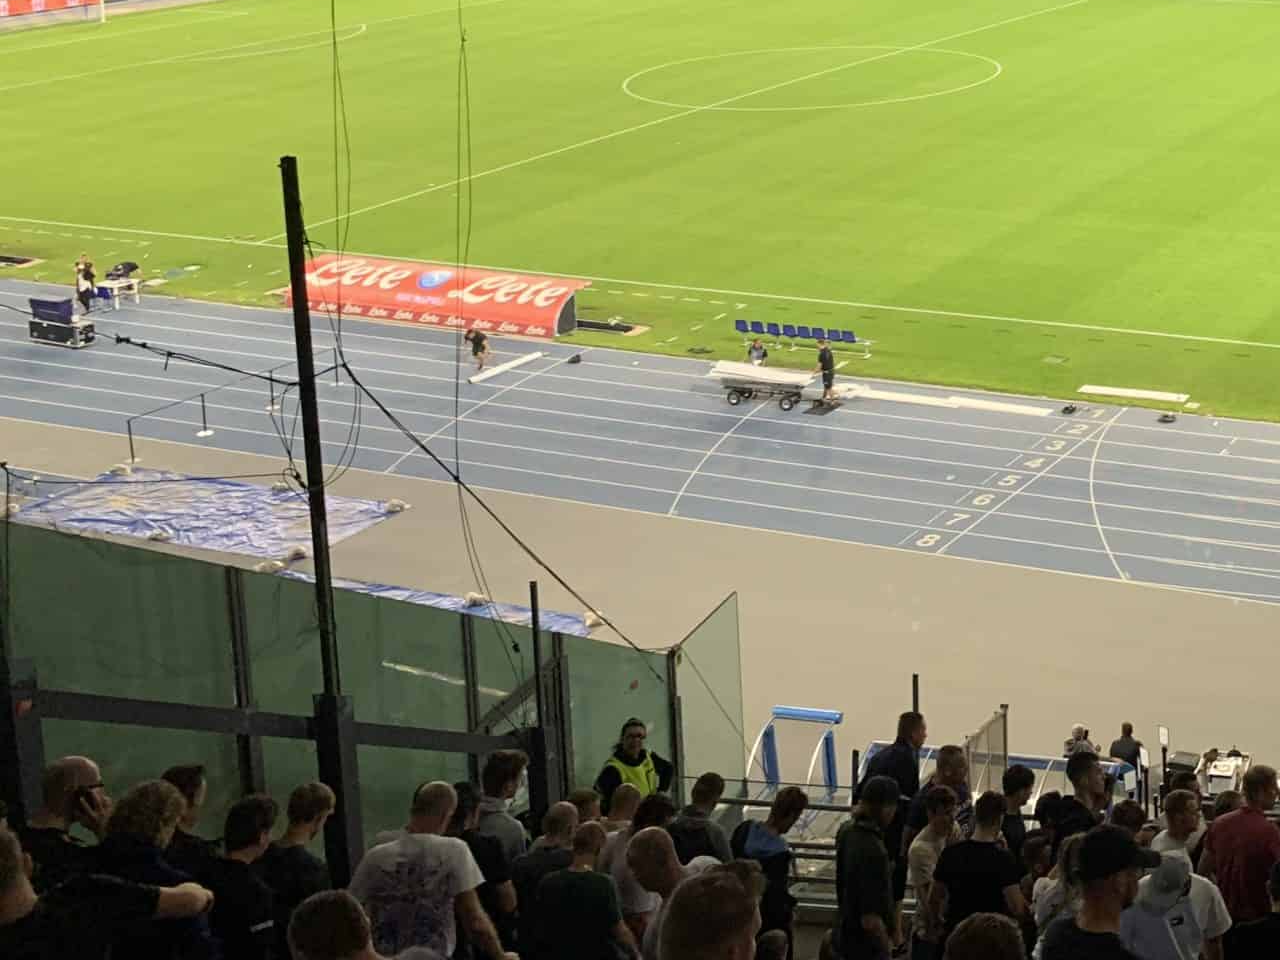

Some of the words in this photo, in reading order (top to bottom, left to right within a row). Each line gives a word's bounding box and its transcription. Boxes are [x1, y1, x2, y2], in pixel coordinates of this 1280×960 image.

[305, 258, 412, 289] Lete
[448, 275, 569, 308] Lete
[1066, 424, 1089, 434] 2
[1045, 440, 1067, 451] 3
[1023, 457, 1047, 468] 4
[997, 475, 1023, 486] 5
[972, 494, 996, 506] 6
[944, 513, 972, 526] 7
[915, 534, 941, 547] 8
